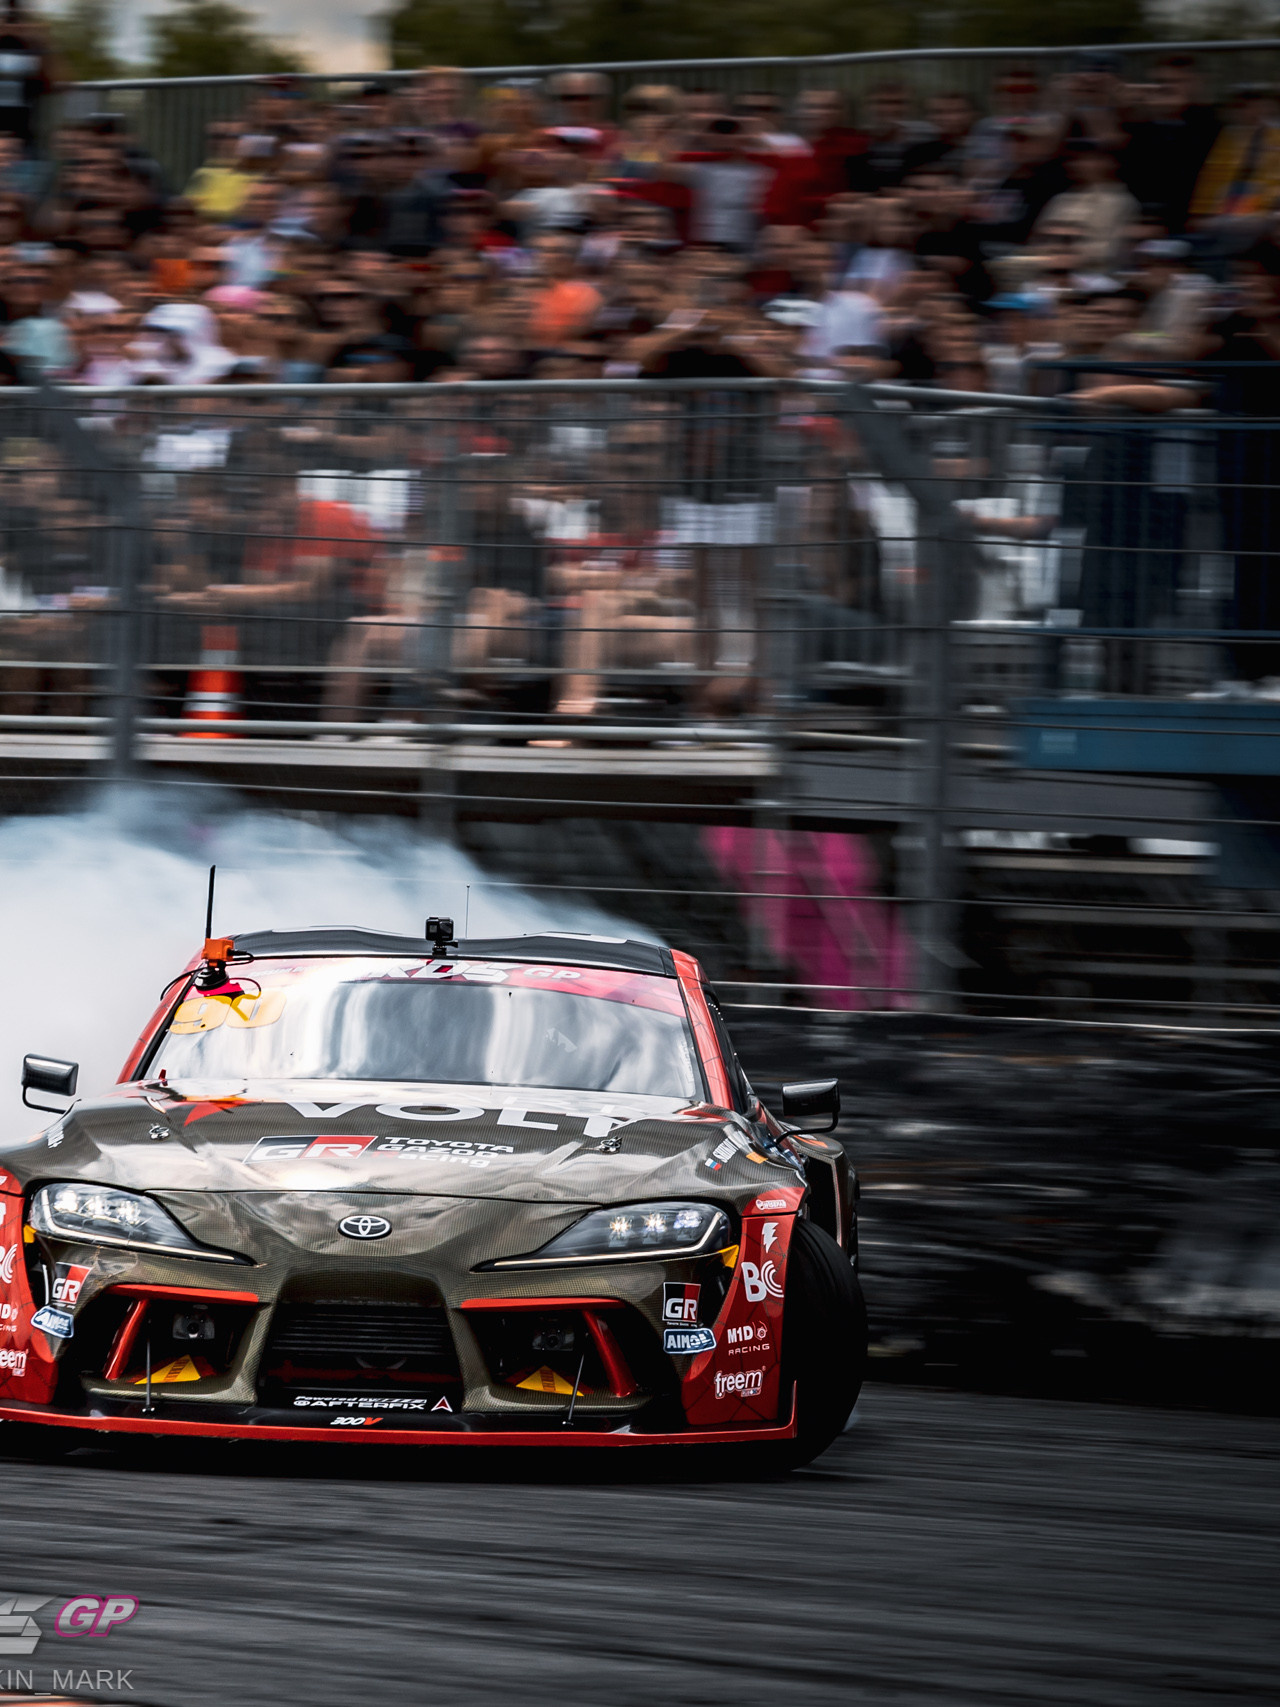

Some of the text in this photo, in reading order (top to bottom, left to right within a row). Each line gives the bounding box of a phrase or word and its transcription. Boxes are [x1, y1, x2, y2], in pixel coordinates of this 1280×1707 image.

[523, 966, 581, 980] GP
[170, 990, 287, 1034] 90
[251, 1143, 365, 1161] GR
[376, 1143, 499, 1159] GAZOO
[384, 1136, 514, 1153] TOYOTA
[370, 1151, 492, 1168] Racing
[52, 1278, 81, 1302] GR
[741, 1260, 784, 1302] BC
[665, 1298, 698, 1320] GR
[727, 1325, 753, 1344] M1D
[728, 1343, 770, 1356] RACING
[715, 1371, 762, 1398] freem
[330, 1416, 384, 1426] 300V
